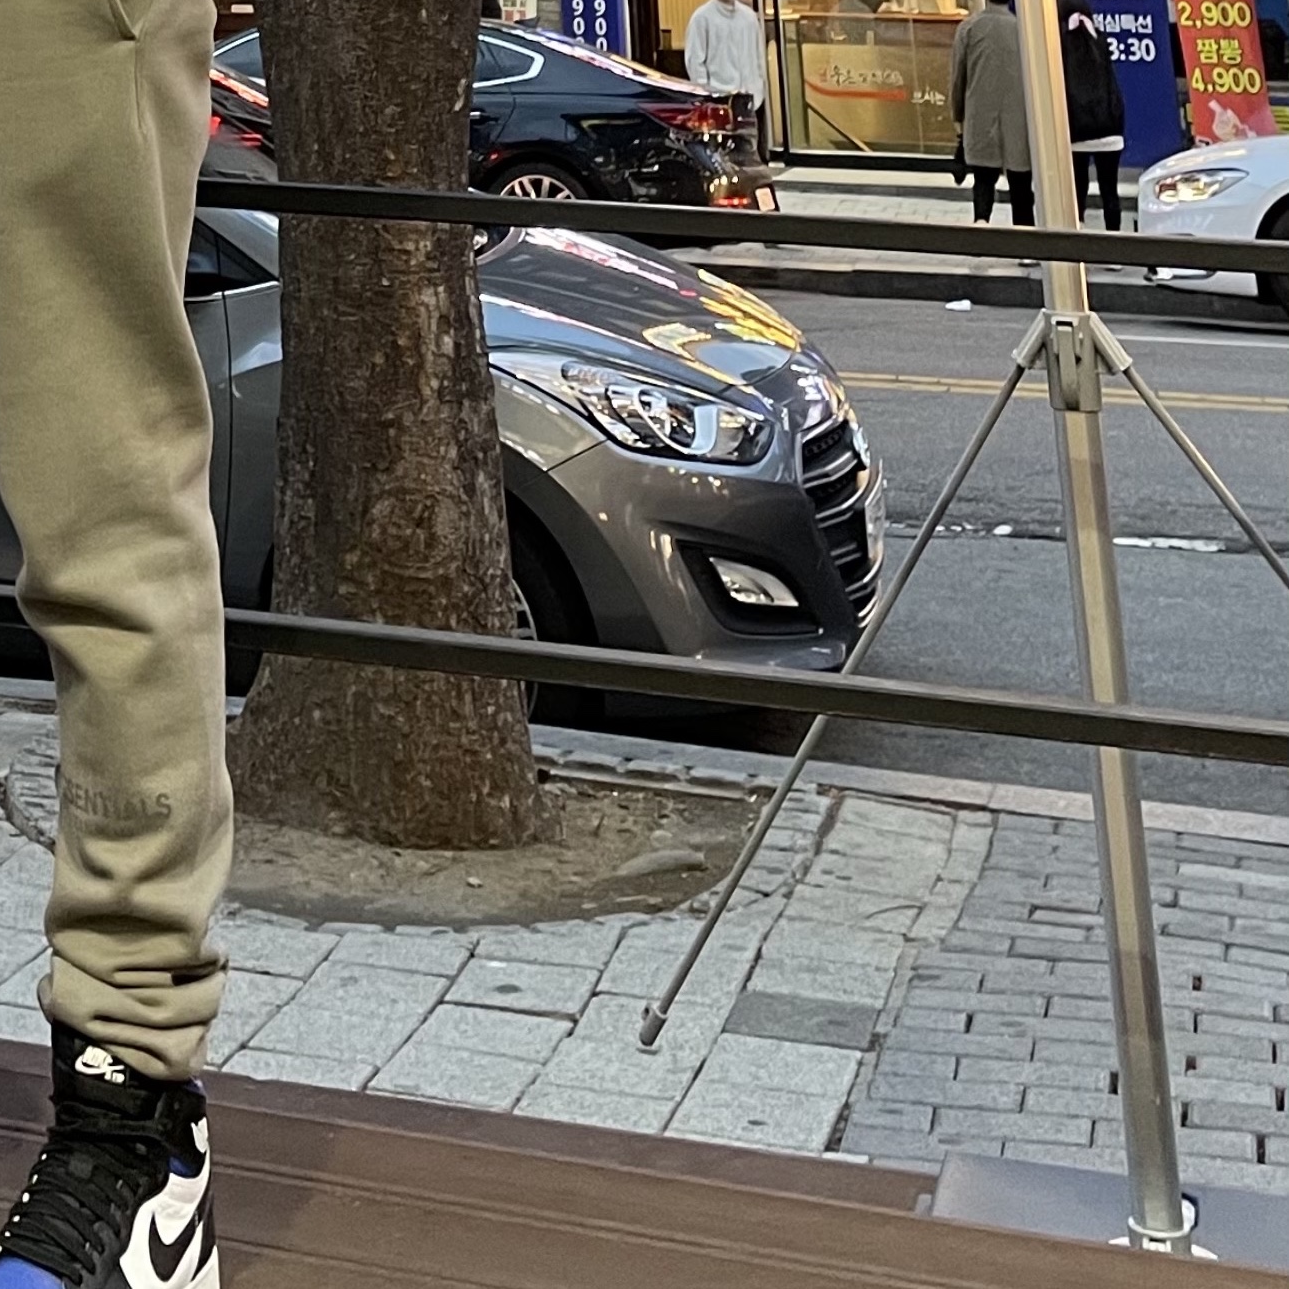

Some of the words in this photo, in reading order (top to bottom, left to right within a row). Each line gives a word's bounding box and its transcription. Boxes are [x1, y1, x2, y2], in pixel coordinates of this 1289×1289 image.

[1176, 0, 1252, 30] 2,900
[1195, 37, 1243, 66] 짬뽕
[1190, 66, 1262, 95] 4,900
